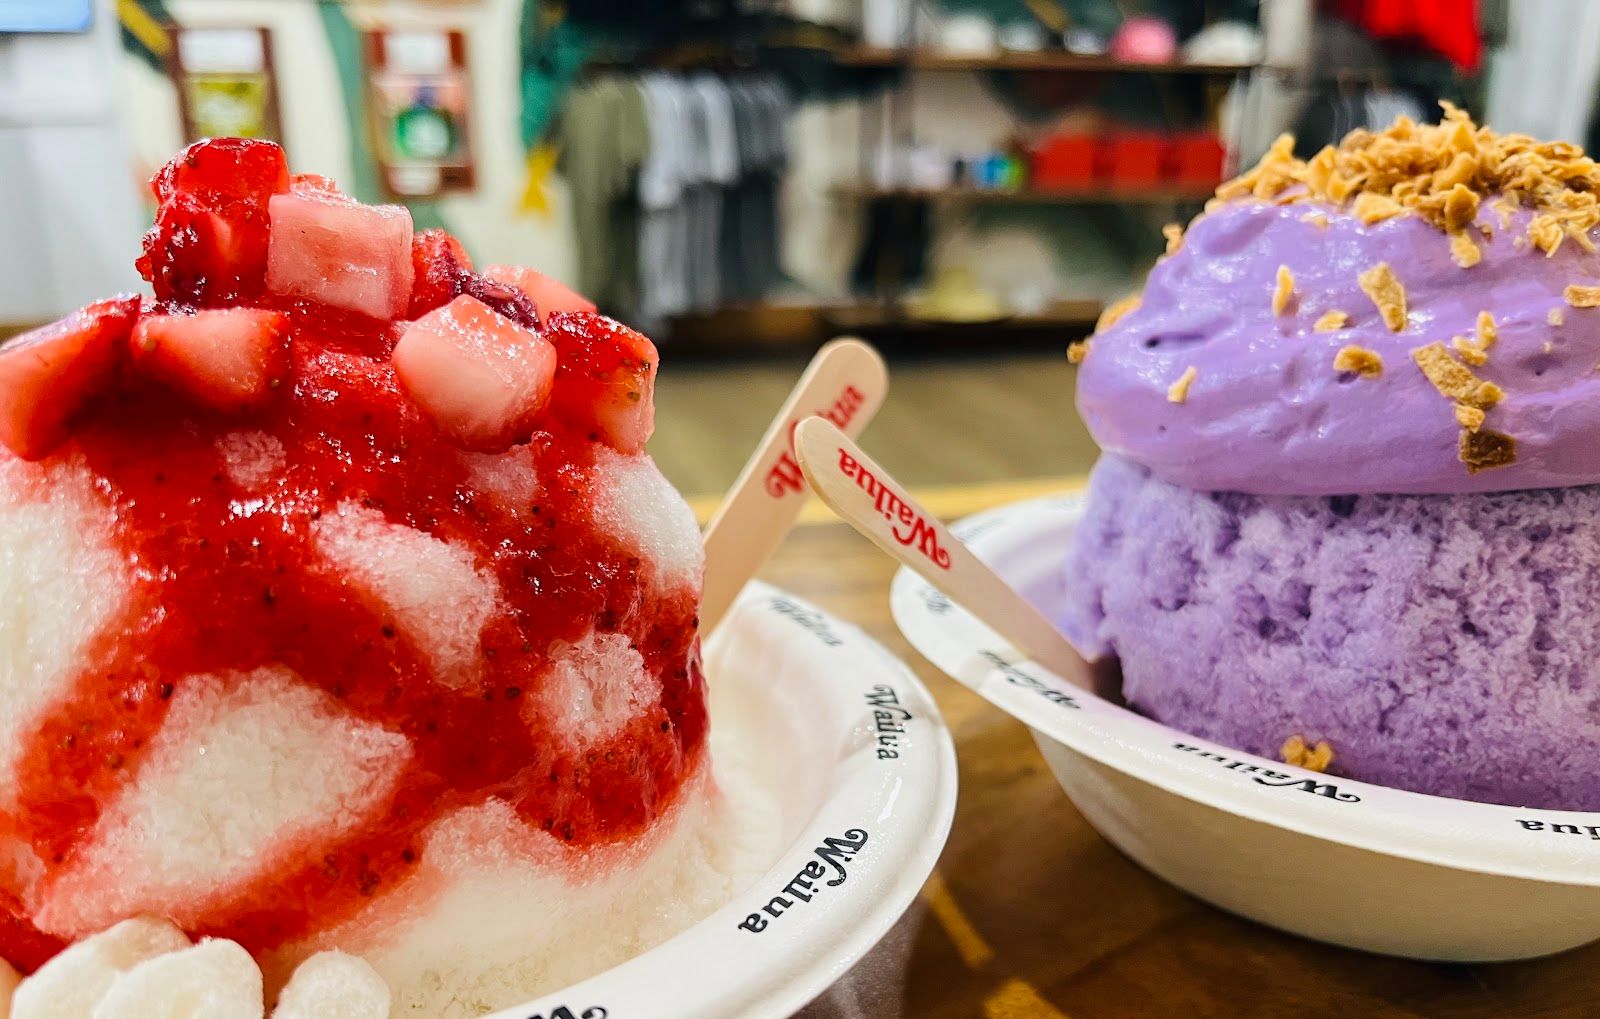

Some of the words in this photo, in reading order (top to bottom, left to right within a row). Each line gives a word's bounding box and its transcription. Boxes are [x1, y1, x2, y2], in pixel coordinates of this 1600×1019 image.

[765, 385, 865, 498] Wua
[838, 448, 951, 570] Wailua
[864, 684, 912, 760] Wailua
[1172, 743, 1361, 803] Wailua
[1515, 819, 1600, 840] lua
[738, 829, 868, 934] Wailua
